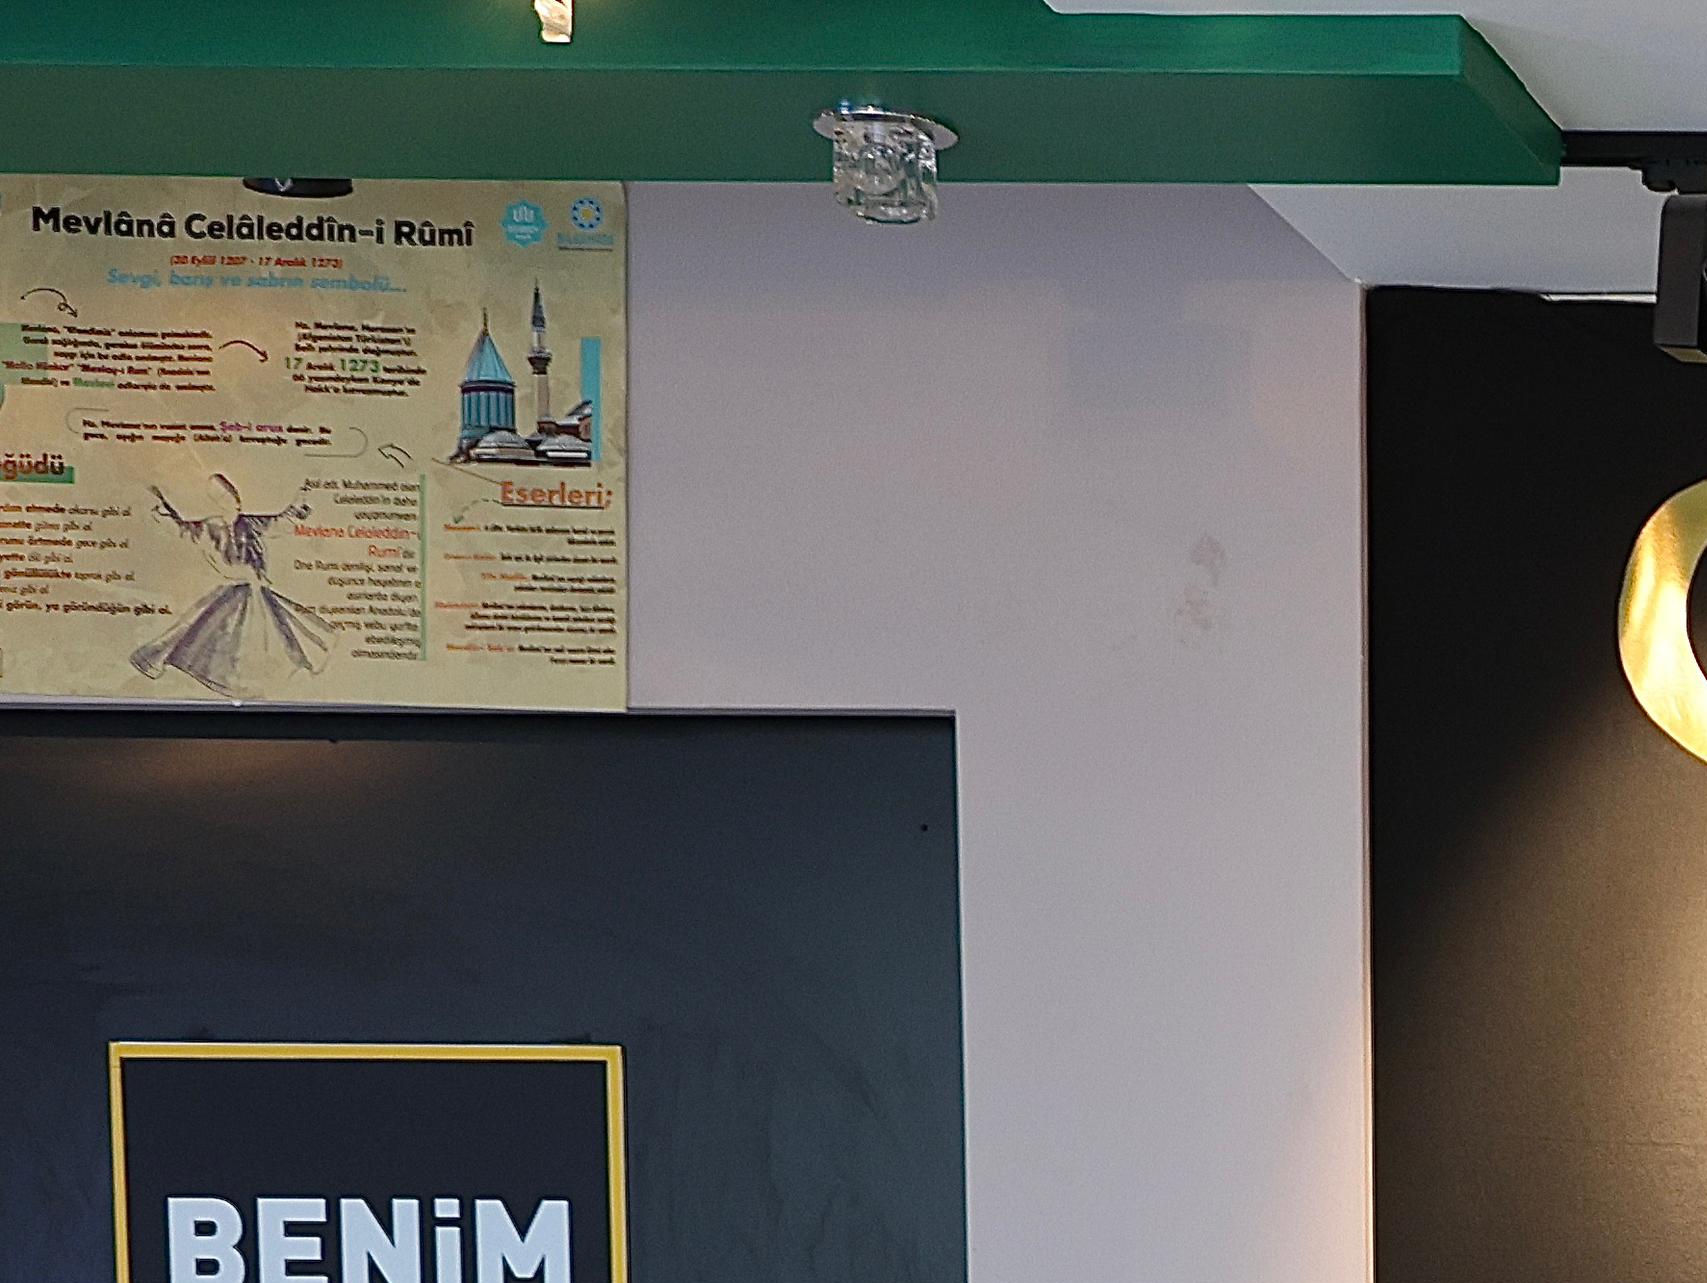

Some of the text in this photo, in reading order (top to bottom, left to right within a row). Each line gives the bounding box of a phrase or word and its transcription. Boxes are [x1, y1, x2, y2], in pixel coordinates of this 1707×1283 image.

[31, 205, 177, 239] Mevlânâ
[184, 211, 385, 246] Celâleddîn-i
[394, 219, 476, 248] Rûmî
[0, 453, 66, 480] ğüdü
[501, 481, 614, 510] Eserleri;
